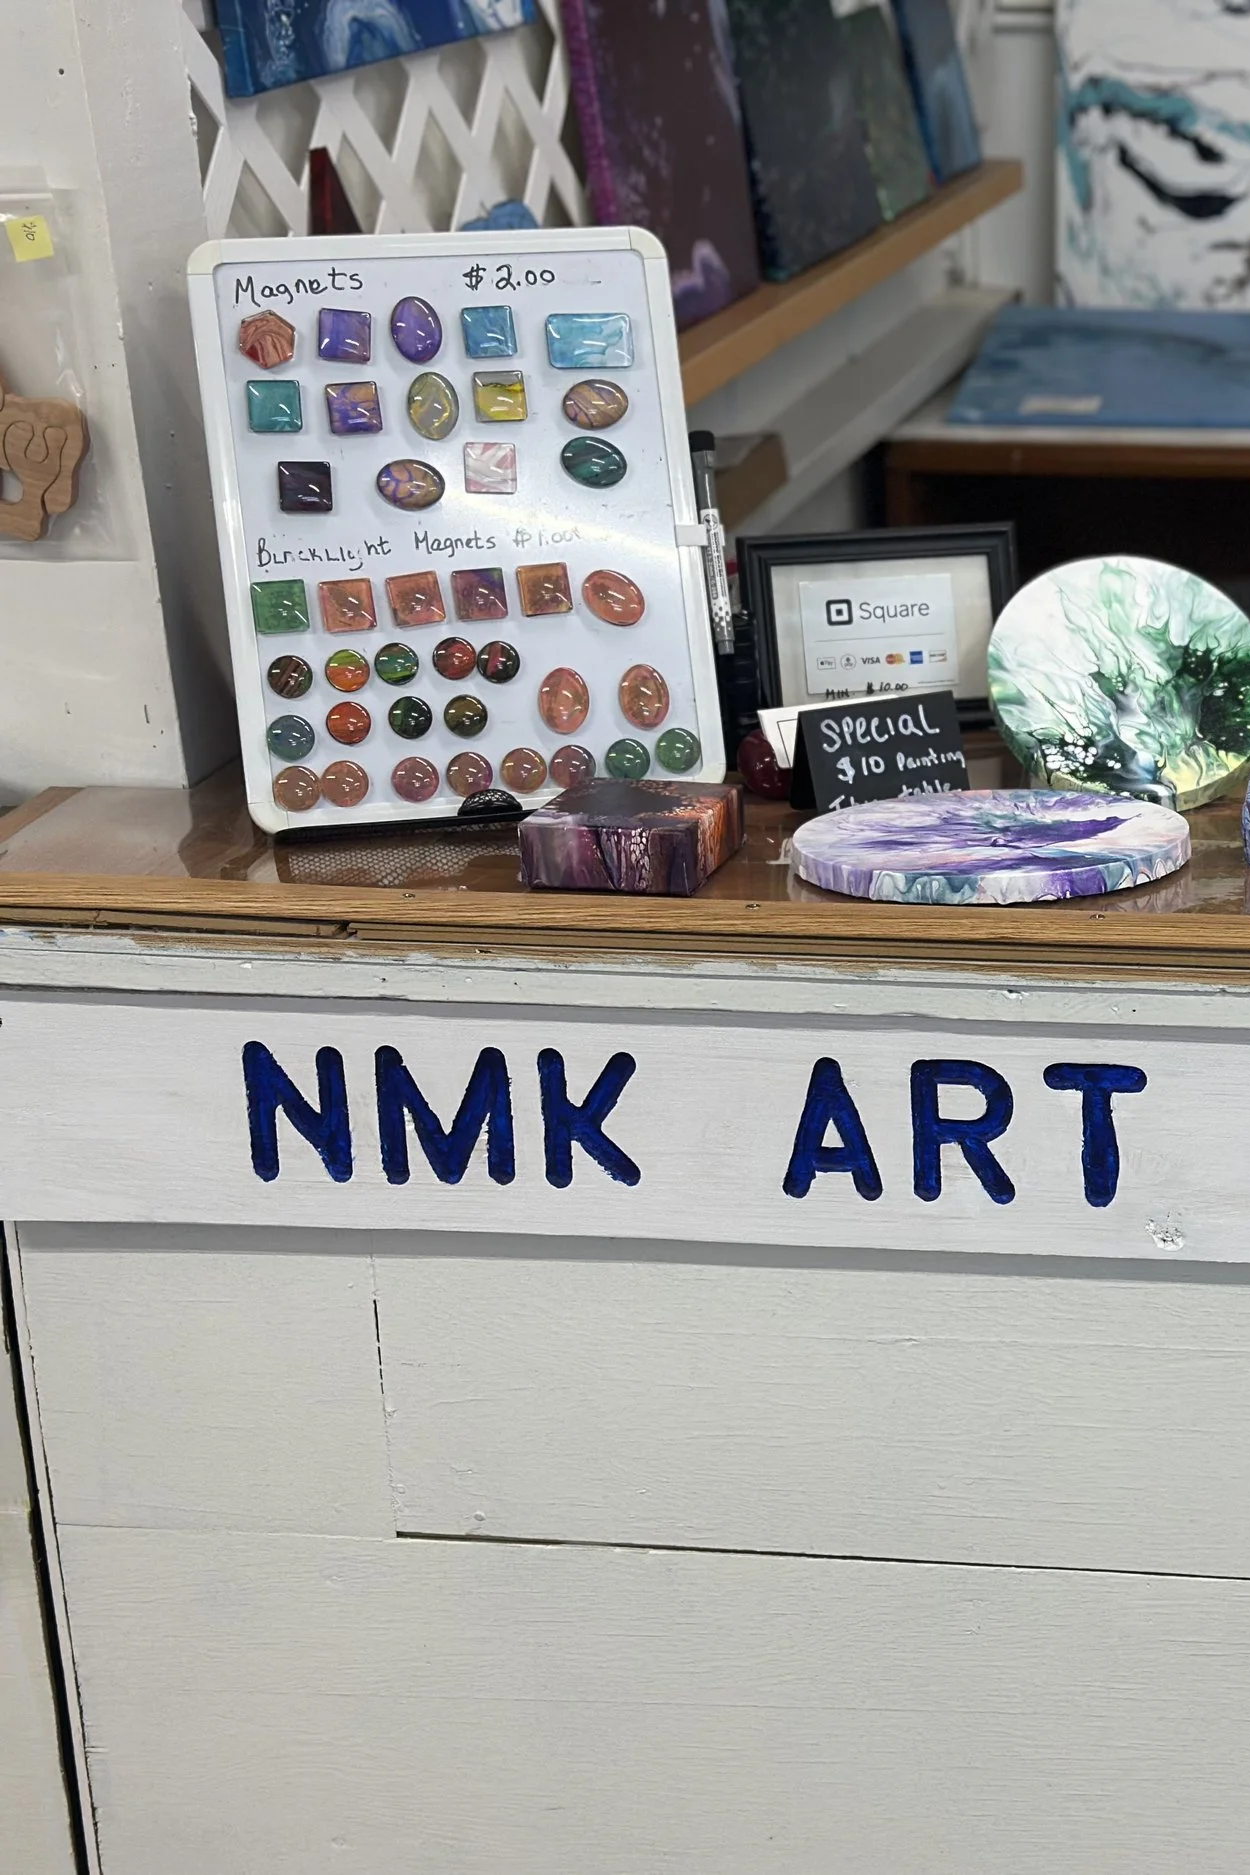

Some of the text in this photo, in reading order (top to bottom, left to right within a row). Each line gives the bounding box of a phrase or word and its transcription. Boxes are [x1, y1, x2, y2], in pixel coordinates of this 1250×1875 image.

[234, 266, 364, 307] Magnets
[413, 529, 497, 558] Magnets
[858, 601, 931, 624] Square
[860, 656, 881, 665] VISA
[896, 748, 967, 772] Painting
[242, 1041, 642, 1188] NMK
[783, 1056, 1148, 1208] ART
